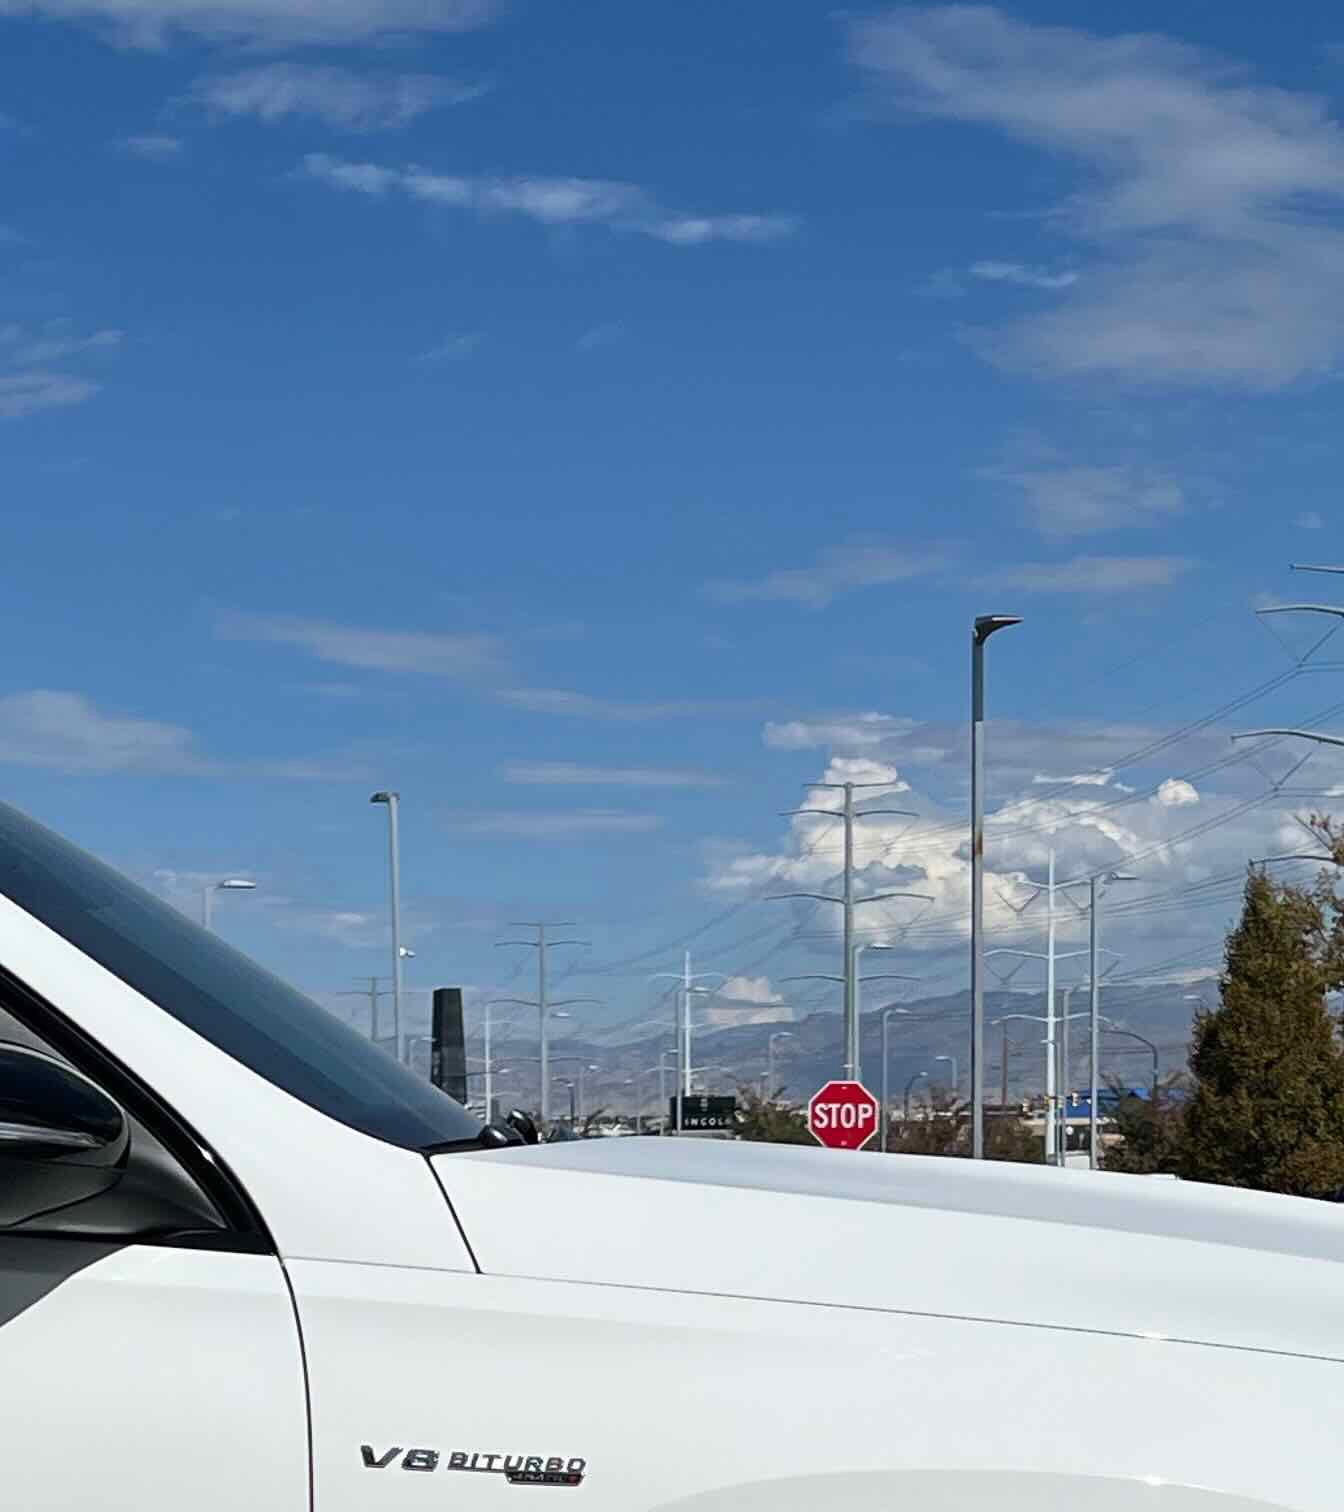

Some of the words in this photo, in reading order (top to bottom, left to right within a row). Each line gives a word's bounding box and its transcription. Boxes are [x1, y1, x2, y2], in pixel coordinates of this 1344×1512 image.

[814, 1103, 873, 1129] STOP
[360, 1445, 440, 1472] V8
[447, 1451, 587, 1474] BITURBO
